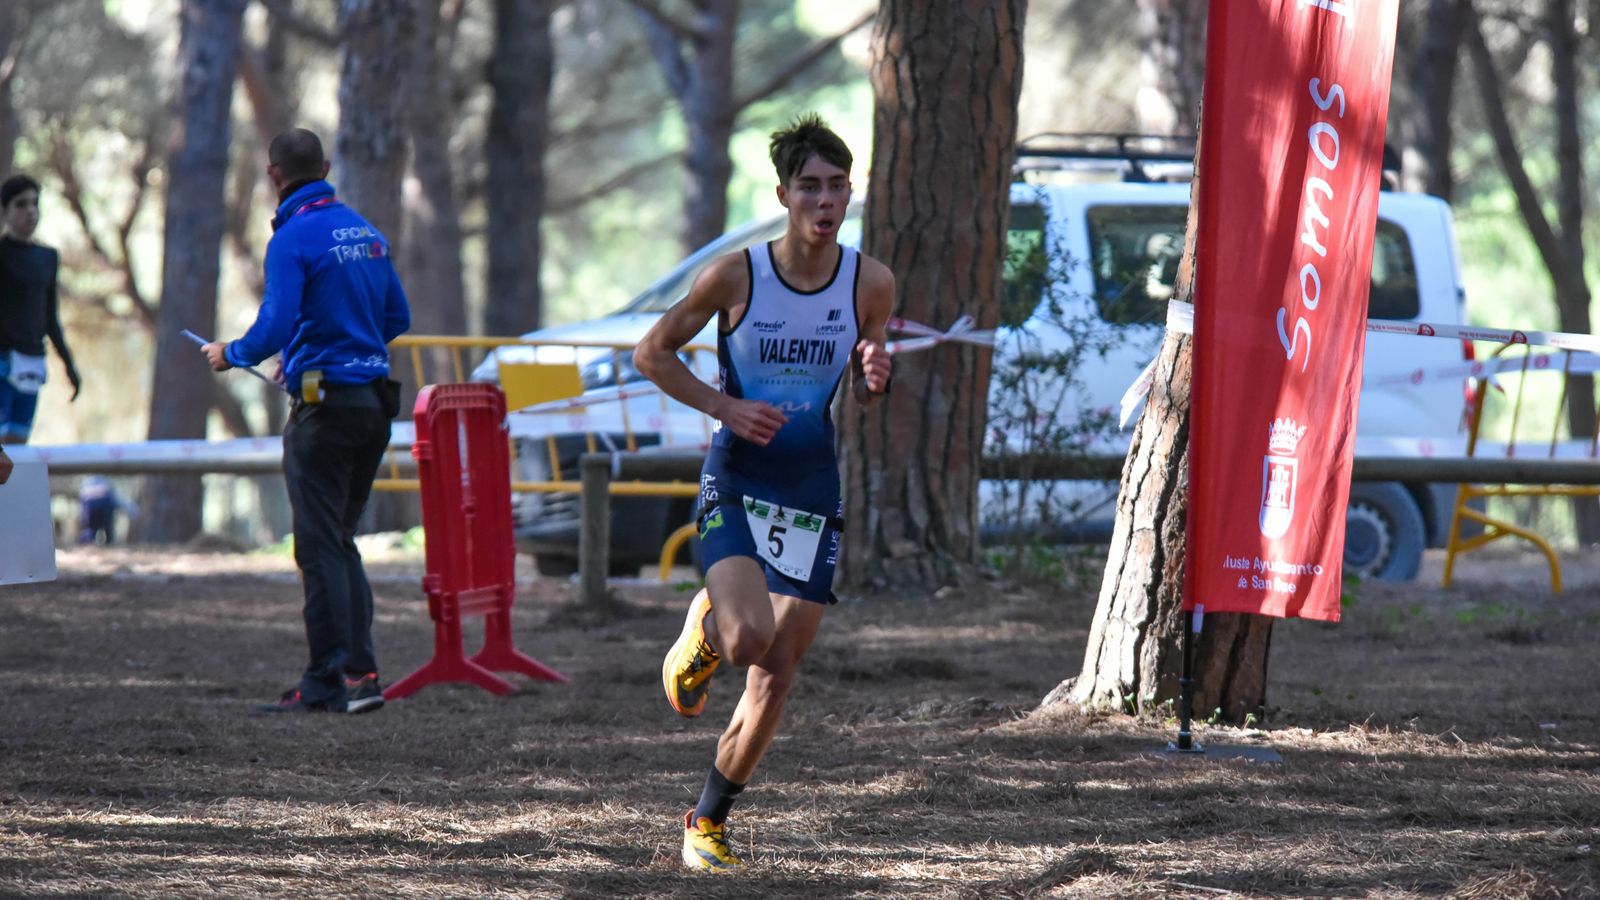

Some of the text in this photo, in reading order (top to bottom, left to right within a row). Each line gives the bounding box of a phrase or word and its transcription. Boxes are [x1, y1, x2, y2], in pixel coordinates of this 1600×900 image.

[1276, 77, 1345, 373] Somos
[760, 338, 836, 366] VALENTIN
[768, 525, 787, 559] 5
[1252, 575, 1272, 590] San
